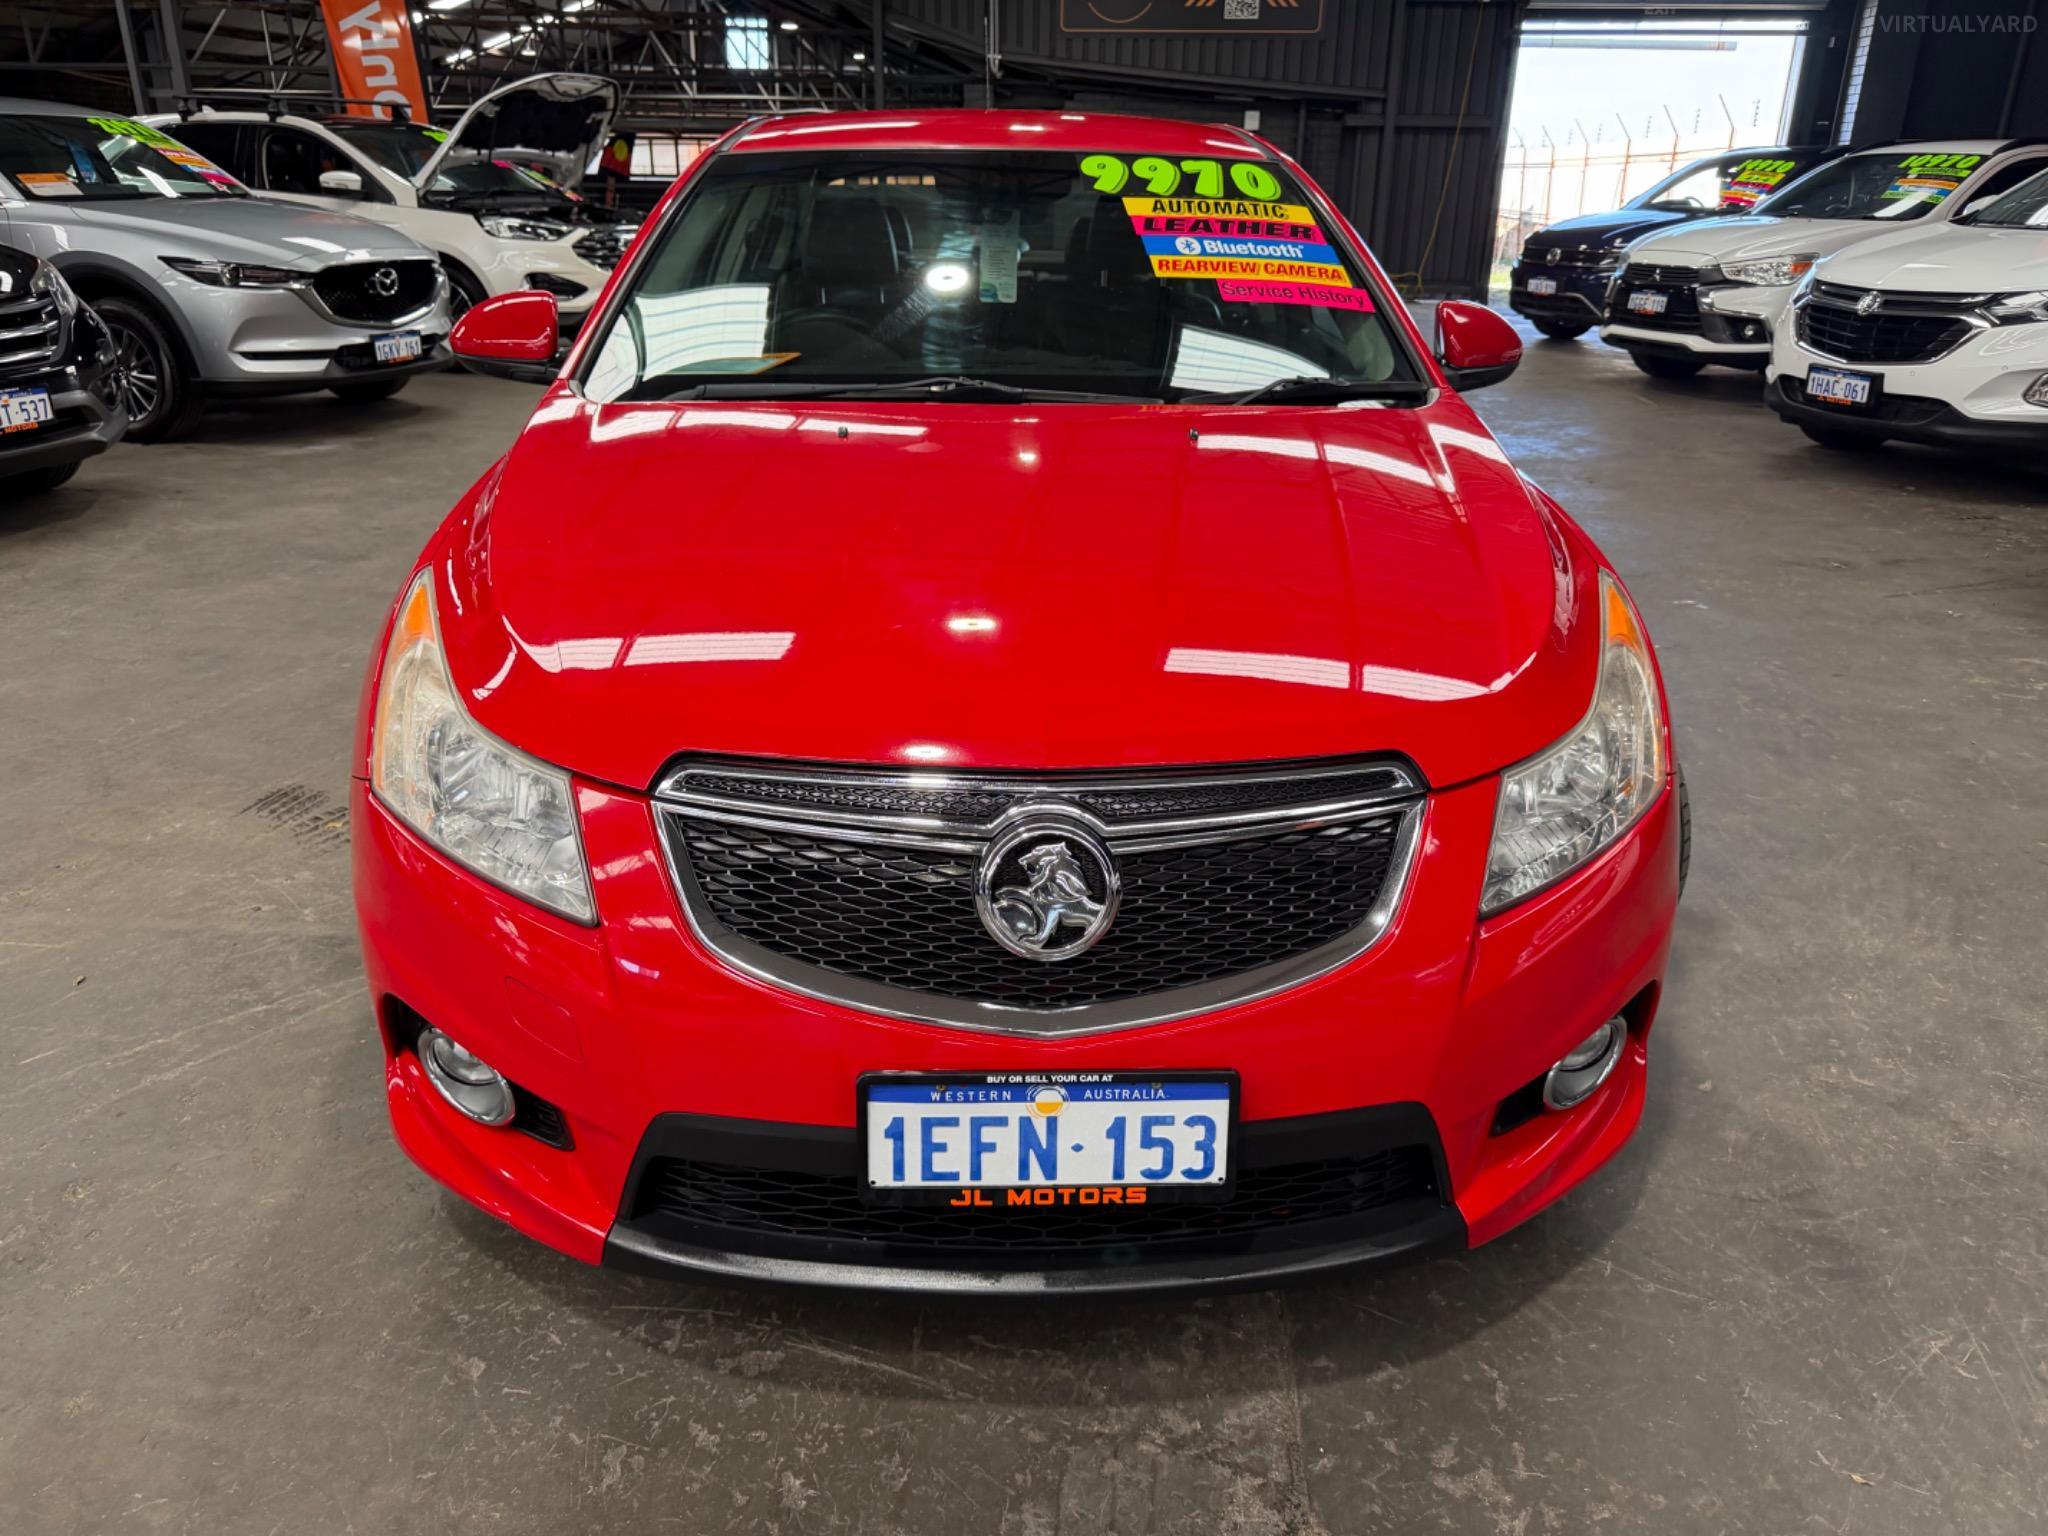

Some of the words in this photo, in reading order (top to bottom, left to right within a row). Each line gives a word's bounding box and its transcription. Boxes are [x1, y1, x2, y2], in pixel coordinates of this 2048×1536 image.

[1080, 154, 1281, 200] 9970
[1151, 199, 1288, 220] AUTOMATIC
[1143, 217, 1314, 240] LEATHER
[1157, 259, 1257, 275] REARVIEW
[1263, 262, 1344, 281] CAMERA
[1221, 282, 1293, 300] Service
[1299, 284, 1365, 309] History
[987, 1075, 1006, 1083] BUY
[1008, 1075, 1022, 1083] OR
[1025, 1074, 1048, 1083] SELL
[1051, 1074, 1077, 1082] YOUR
[1079, 1074, 1099, 1082] CAR
[1101, 1074, 1113, 1082] AT
[930, 1090, 1012, 1102] WESTERN
[1083, 1088, 1165, 1100] AUSTRALIA
[950, 1189, 993, 1206] JL
[1007, 1186, 1147, 1206] MOTORS
